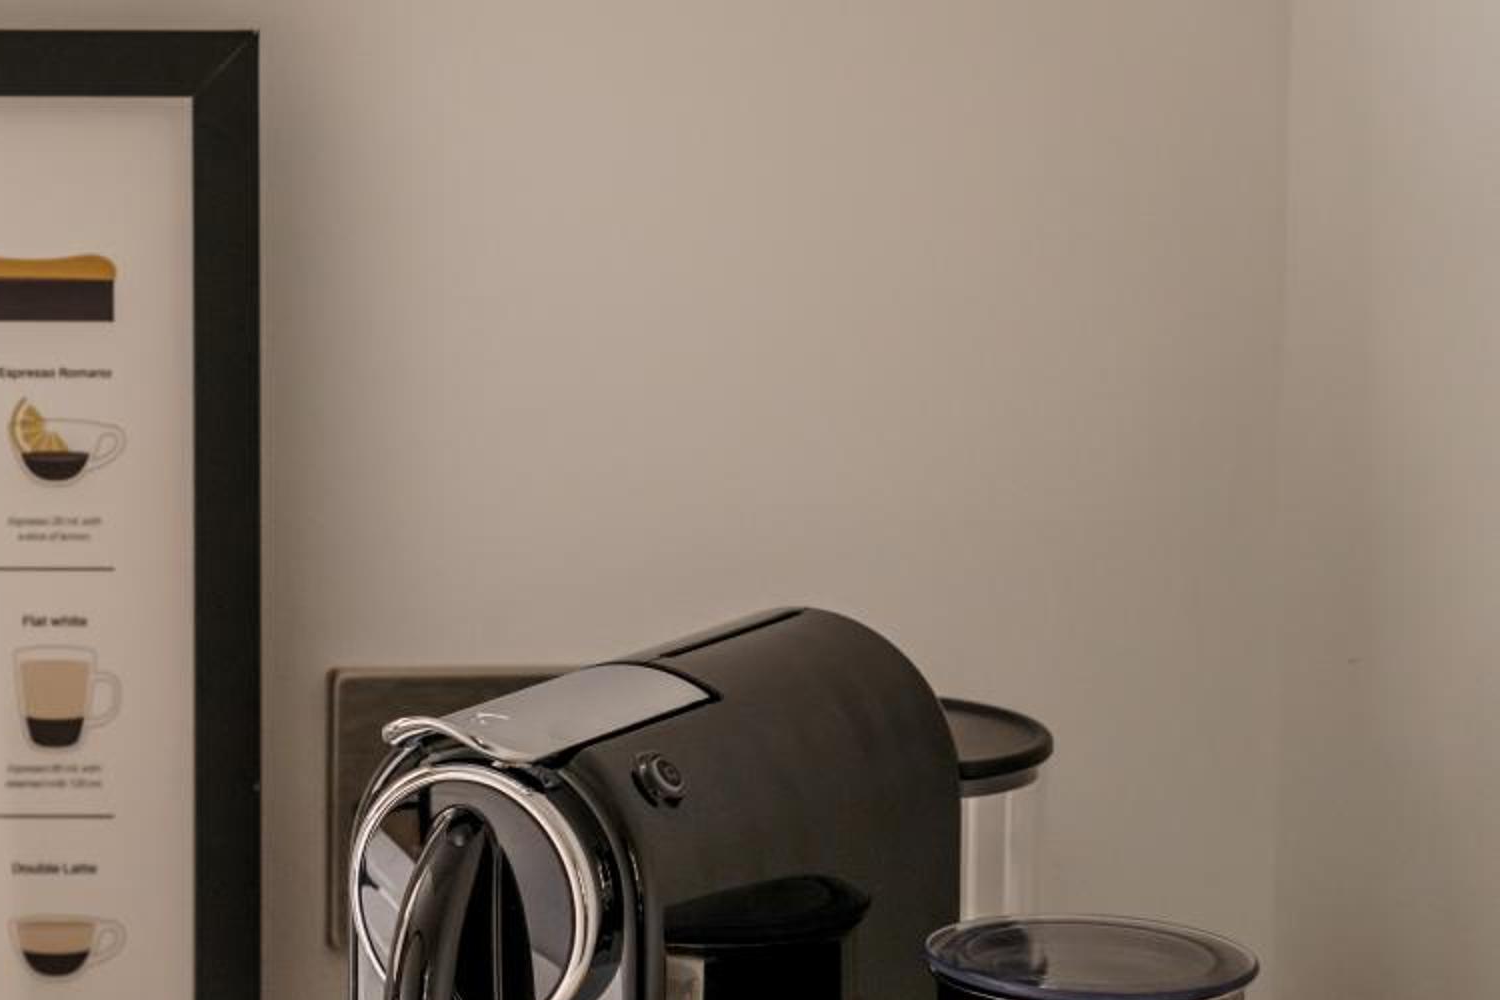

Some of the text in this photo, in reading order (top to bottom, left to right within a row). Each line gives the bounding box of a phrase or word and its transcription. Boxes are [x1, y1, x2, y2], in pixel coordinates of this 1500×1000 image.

[58, 365, 113, 380] Romano
[21, 614, 88, 628] Flat white
[11, 861, 98, 876] Double Latte
